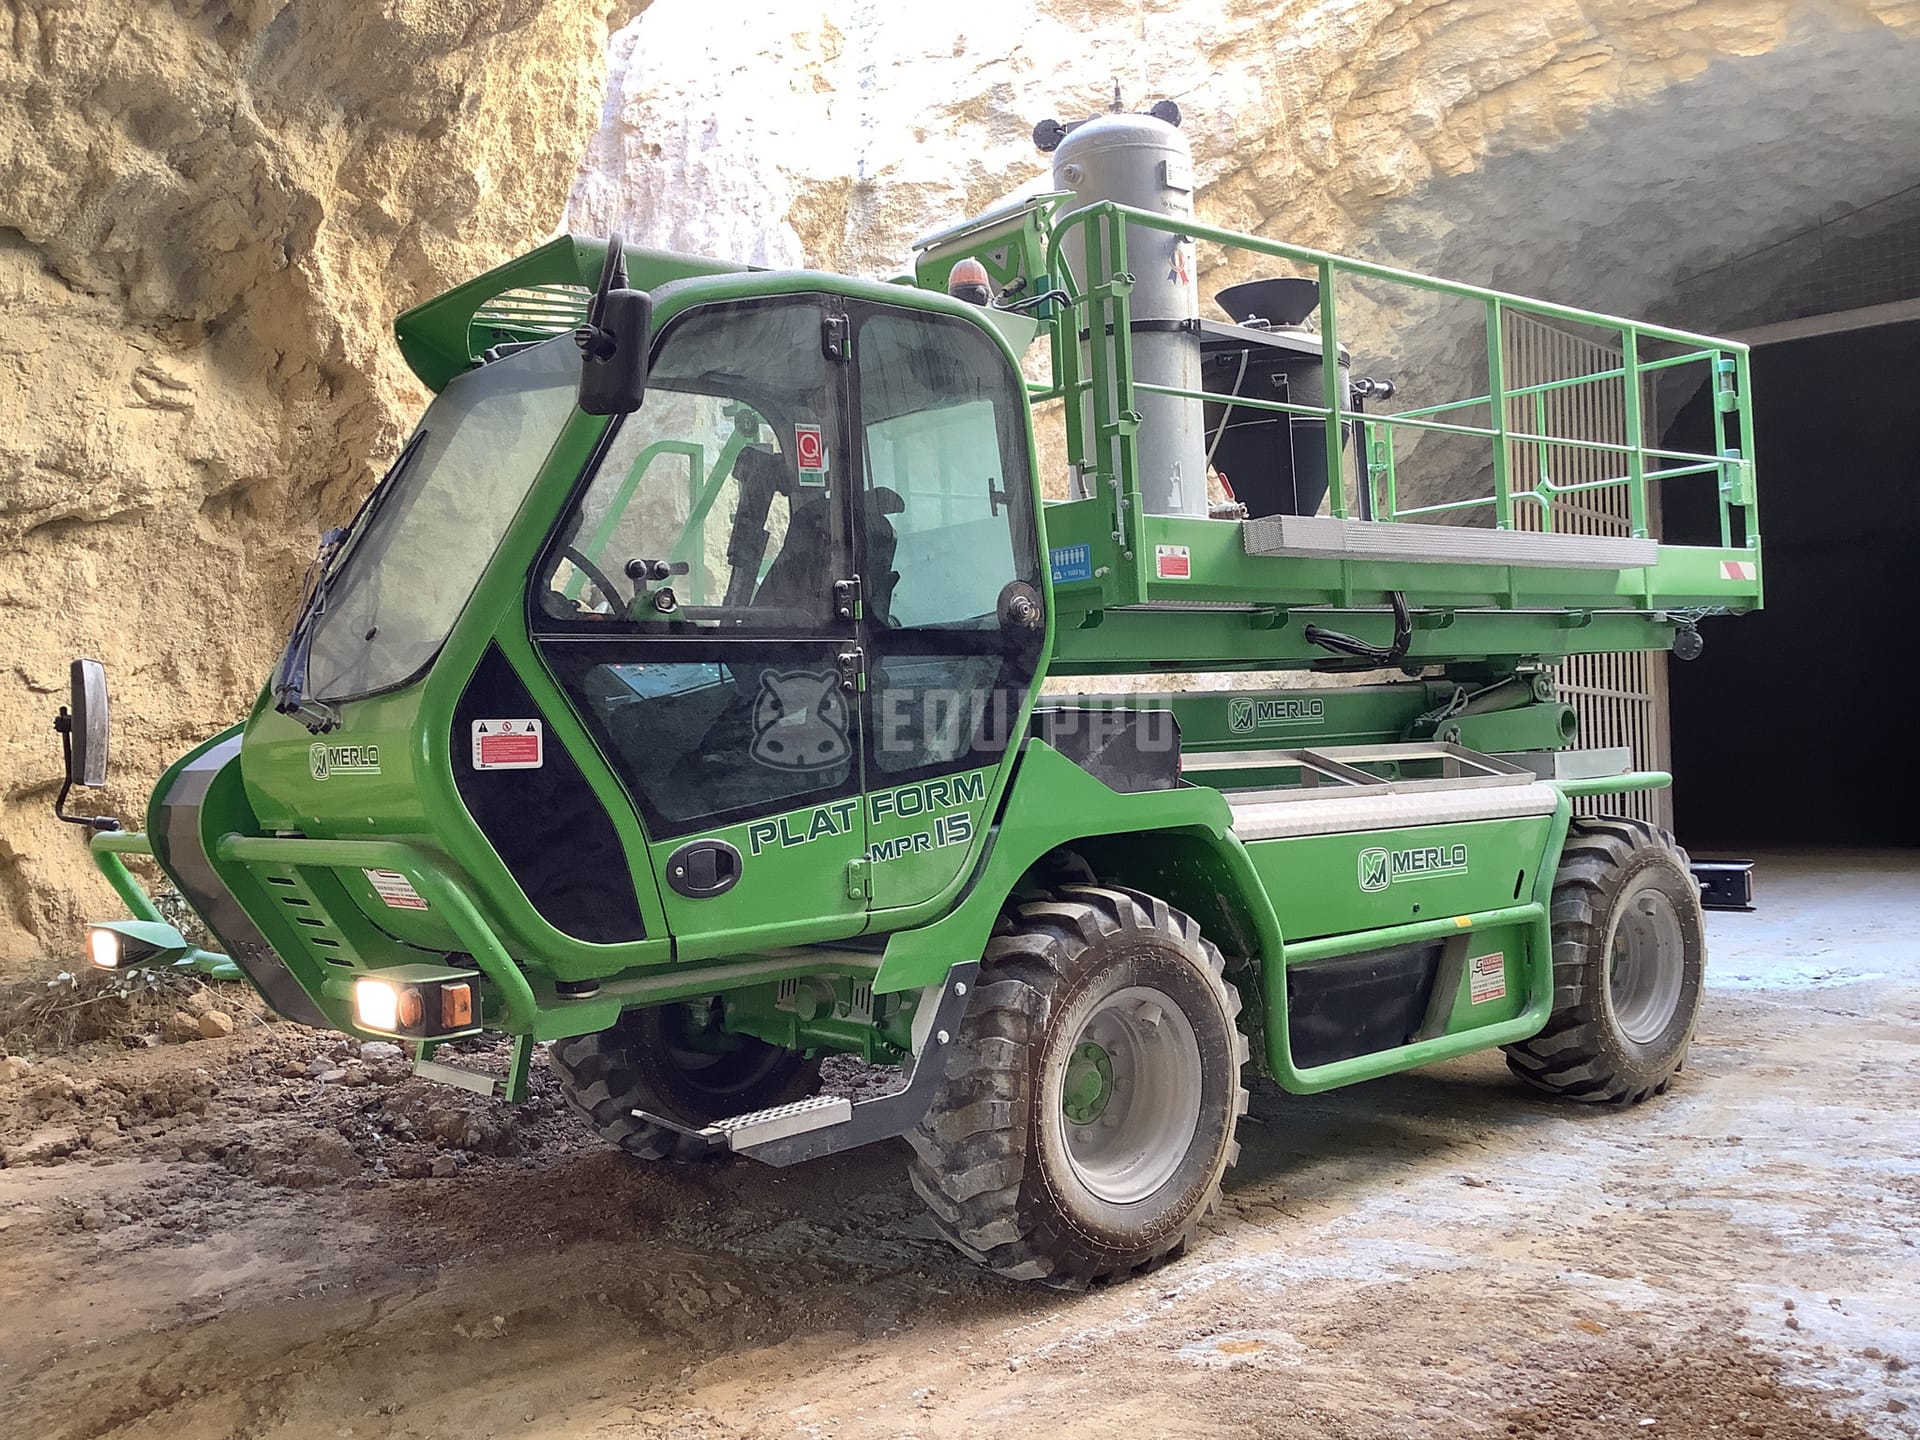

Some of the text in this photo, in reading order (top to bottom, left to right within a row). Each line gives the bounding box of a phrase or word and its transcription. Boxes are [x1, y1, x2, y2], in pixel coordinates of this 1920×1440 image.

[1257, 699, 1324, 720] MERLO
[329, 745, 380, 767] MERLO
[869, 811, 973, 865] MPR 15
[1391, 843, 1468, 874] MERLO
